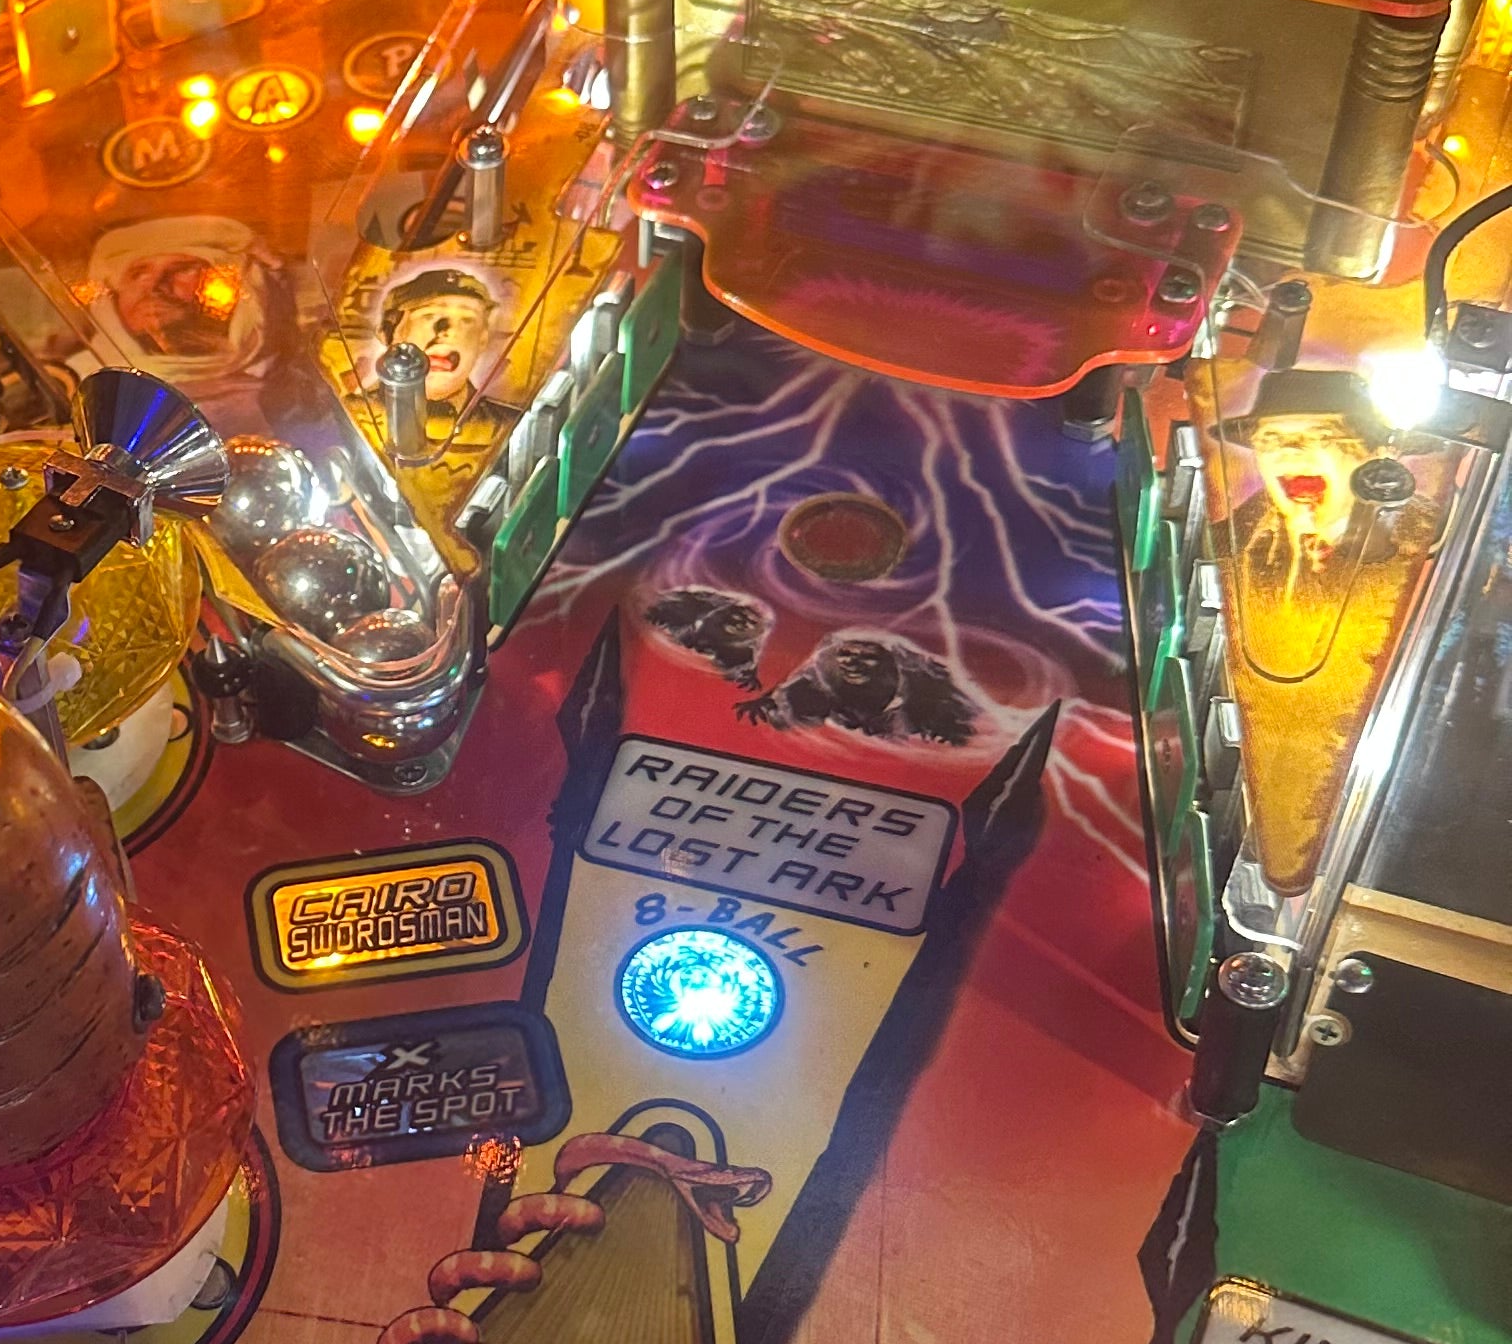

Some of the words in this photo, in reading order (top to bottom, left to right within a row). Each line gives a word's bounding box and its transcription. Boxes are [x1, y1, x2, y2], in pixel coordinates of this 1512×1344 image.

[133, 129, 182, 169] M
[624, 754, 925, 837] RAIDERS
[649, 795, 734, 825] OF
[747, 815, 861, 858] THE
[597, 820, 759, 874] LOST
[767, 859, 913, 913] ARK
[289, 870, 478, 925] CAIRO
[288, 903, 488, 960] SWORDSMAN
[634, 892, 825, 968] 8-BALL
[385, 1042, 434, 1070] X
[322, 1103, 402, 1136] THE
[413, 1087, 521, 1124] SPOT
[331, 1065, 499, 1107] MARKS
